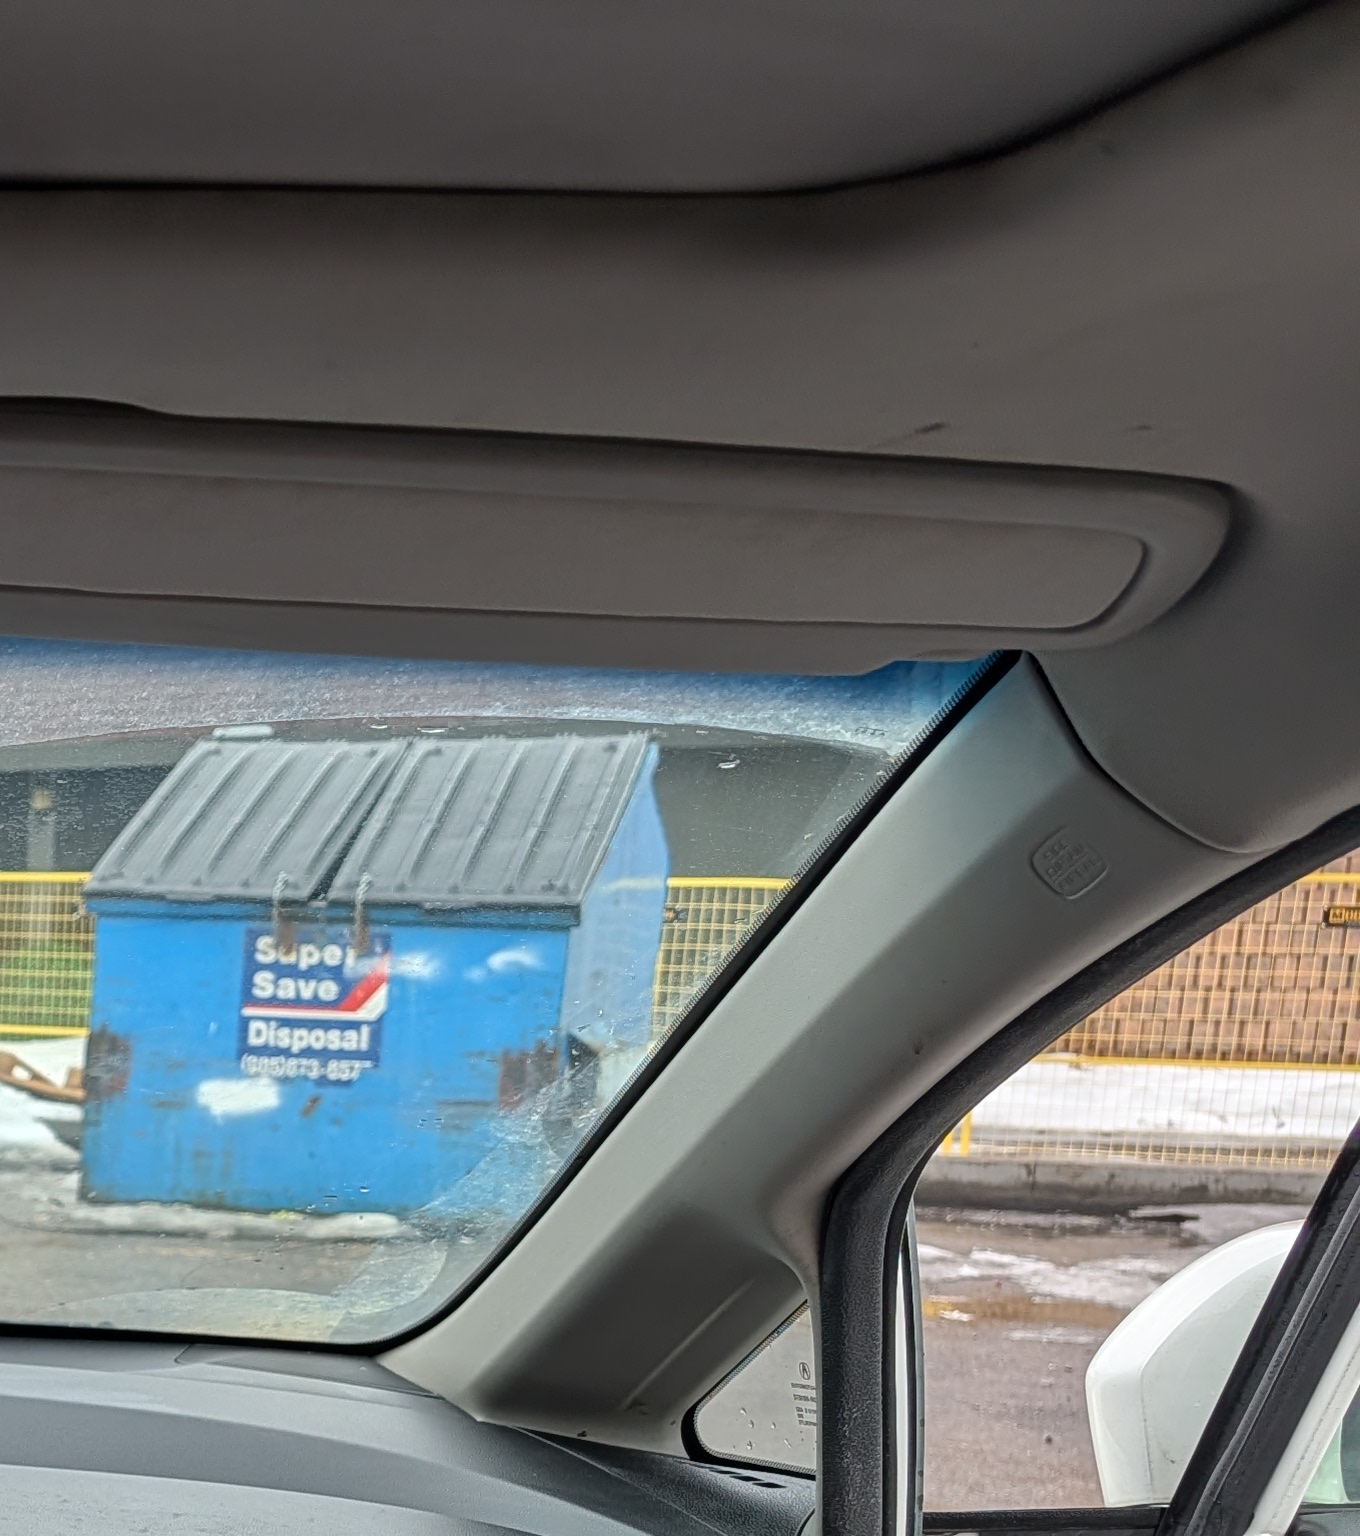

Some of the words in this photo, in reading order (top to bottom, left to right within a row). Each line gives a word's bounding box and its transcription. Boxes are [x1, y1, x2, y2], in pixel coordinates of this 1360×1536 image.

[254, 935, 357, 971] Super
[251, 970, 341, 1002] Save
[247, 1019, 371, 1054] Disposal
